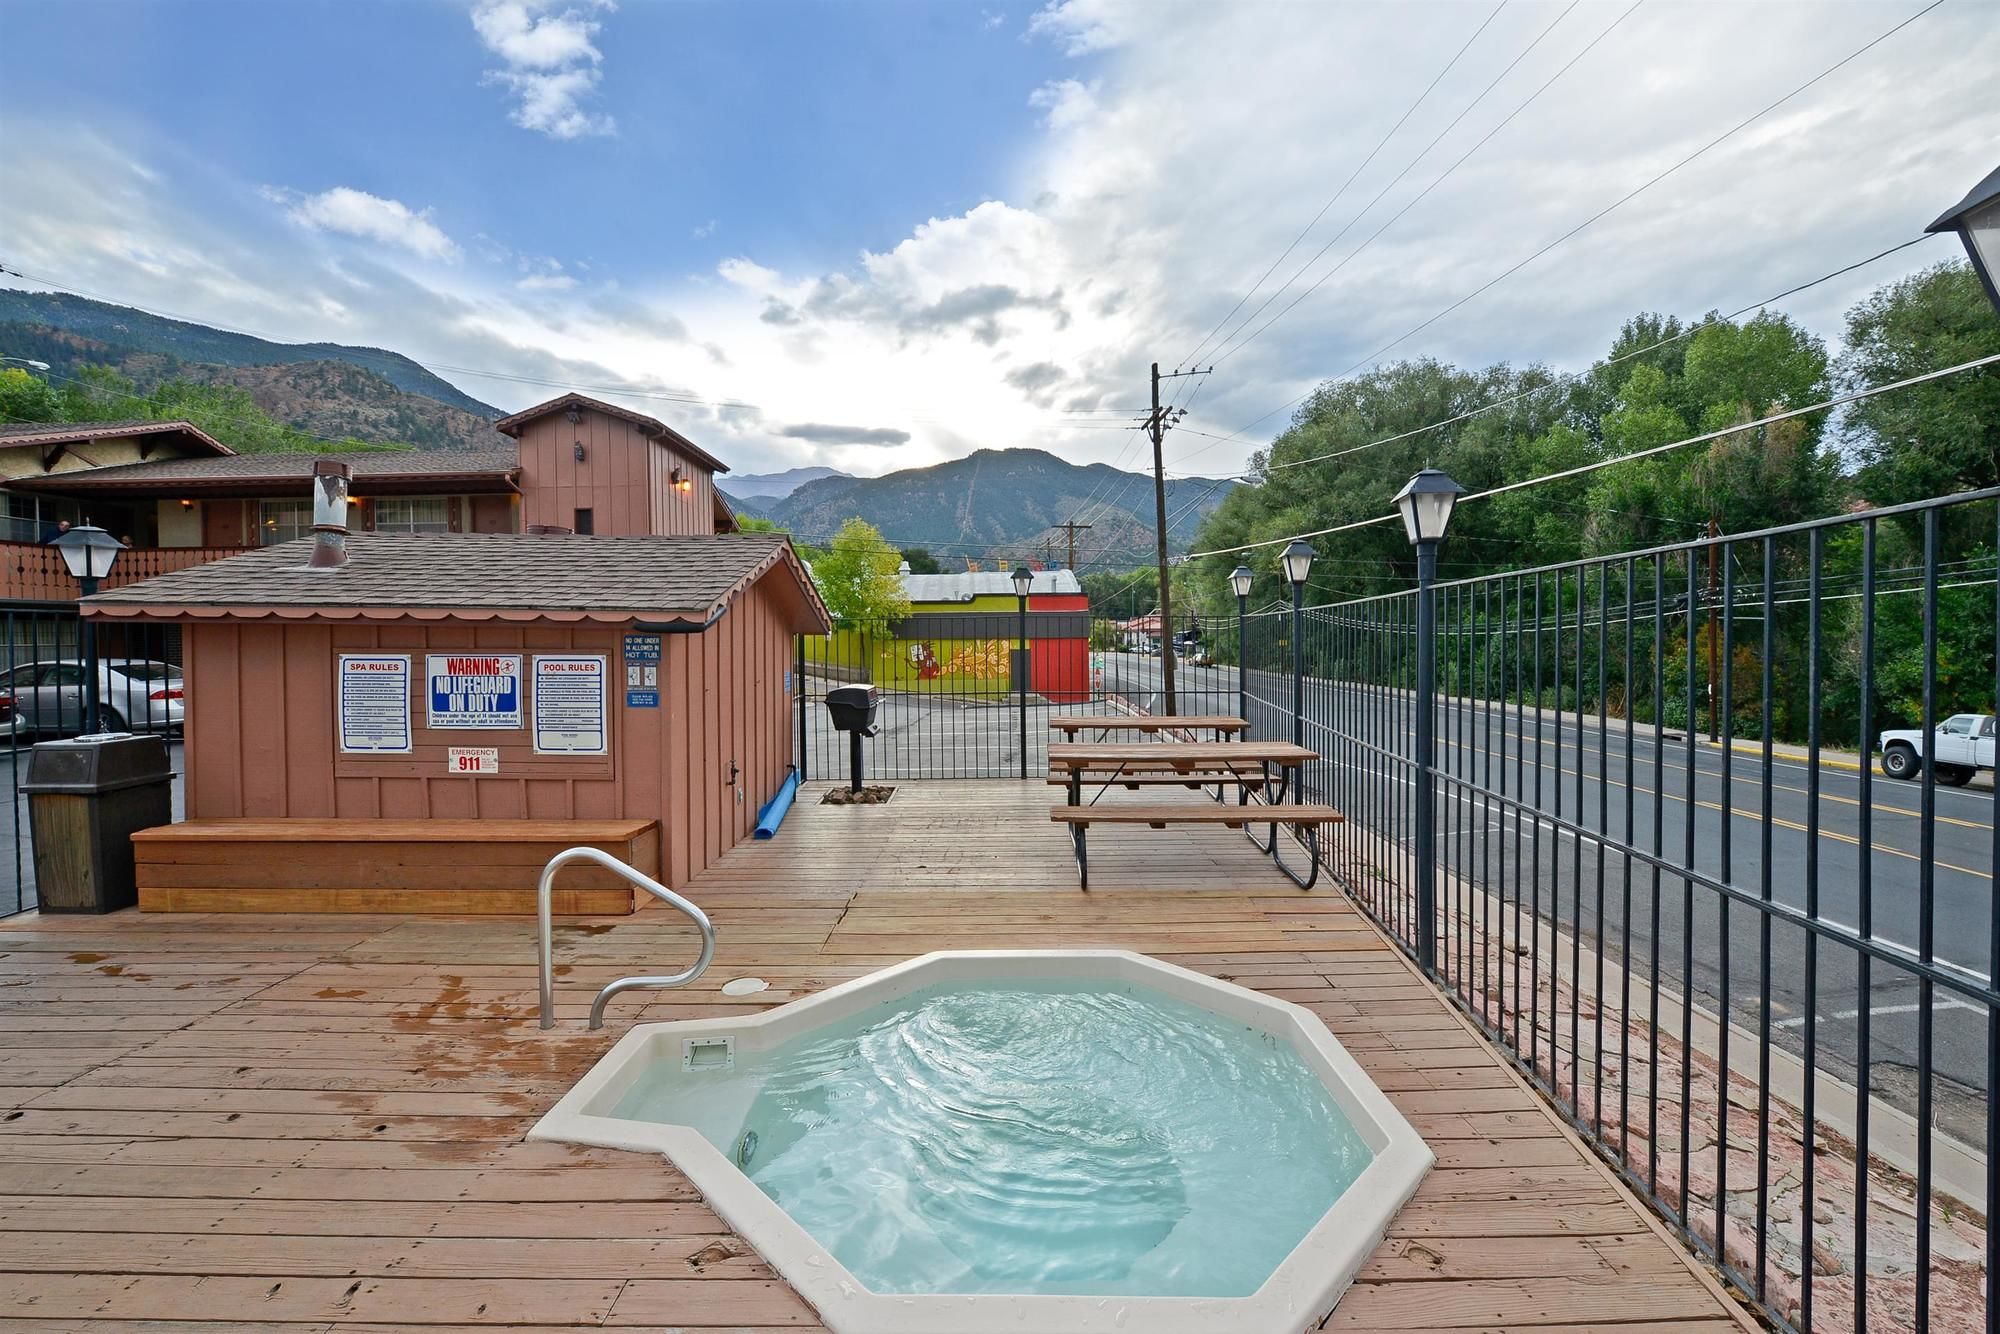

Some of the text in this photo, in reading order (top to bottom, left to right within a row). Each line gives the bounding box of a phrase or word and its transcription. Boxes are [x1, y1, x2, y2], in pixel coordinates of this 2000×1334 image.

[447, 658, 500, 675] WARNING
[436, 676, 511, 694] NO LIFEGUARD
[449, 694, 498, 712] ON DUTY
[459, 756, 480, 771] 911
